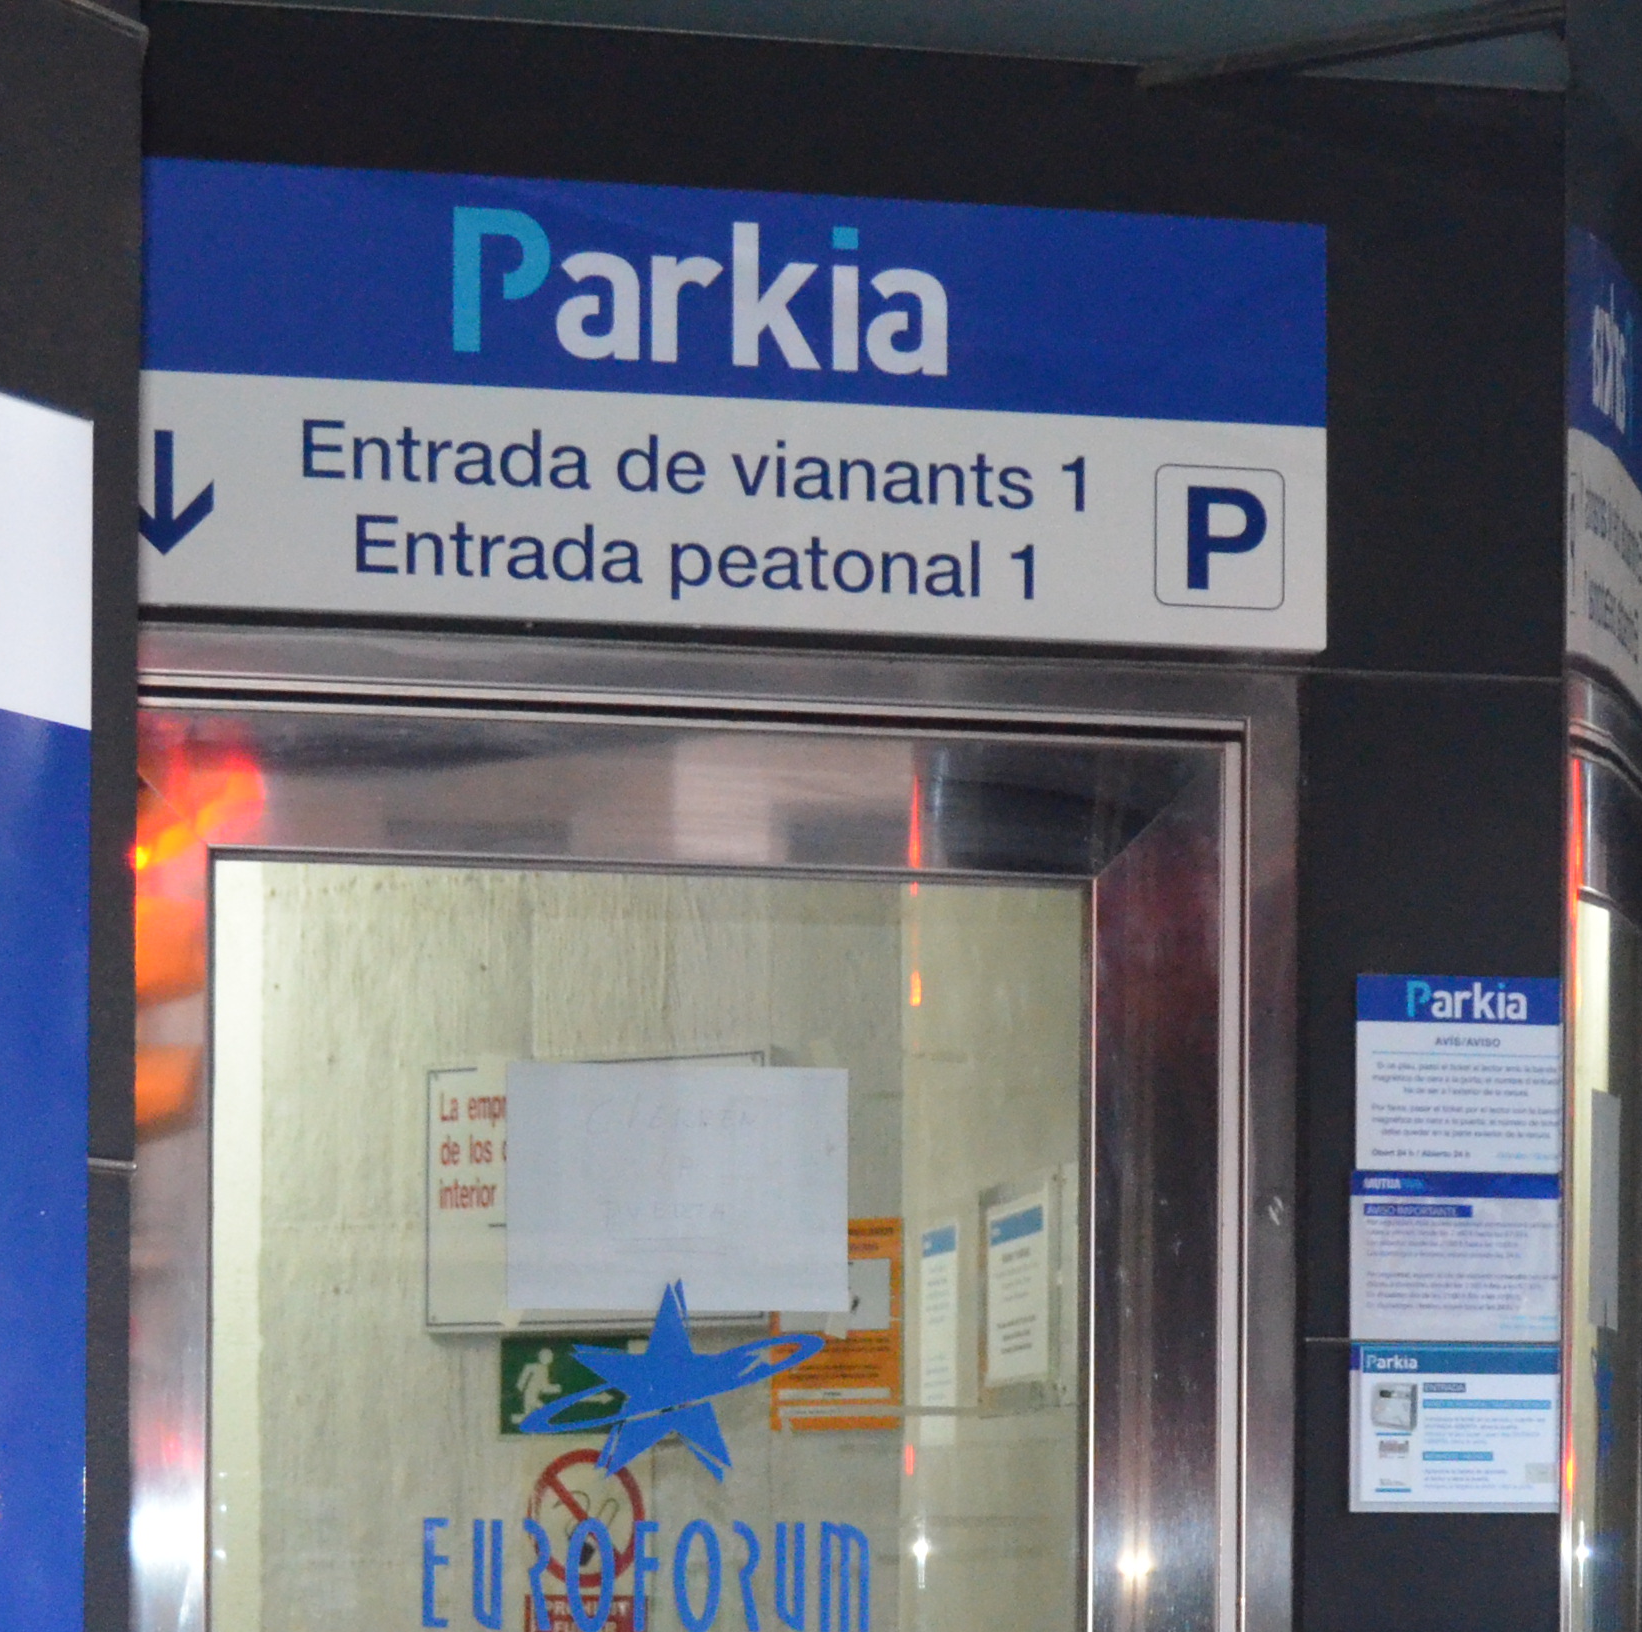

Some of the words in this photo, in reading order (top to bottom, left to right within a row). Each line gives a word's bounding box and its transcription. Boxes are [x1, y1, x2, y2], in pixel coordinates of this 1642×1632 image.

[452, 206, 949, 375] Parkia
[302, 418, 591, 491] Entrada
[616, 433, 706, 495] de
[731, 439, 1035, 512] vianants
[1063, 456, 1087, 512] 1
[355, 513, 643, 585] Entrada
[670, 537, 981, 601] peatonal
[1008, 544, 1036, 600] 1
[1186, 485, 1268, 591] P
[1405, 979, 1528, 1021] Parkia
[440, 1092, 459, 1121] La
[440, 1134, 461, 1165] de
[469, 1133, 493, 1165] los
[439, 1177, 498, 1210] interior
[1366, 1354, 1418, 1370] Parkia
